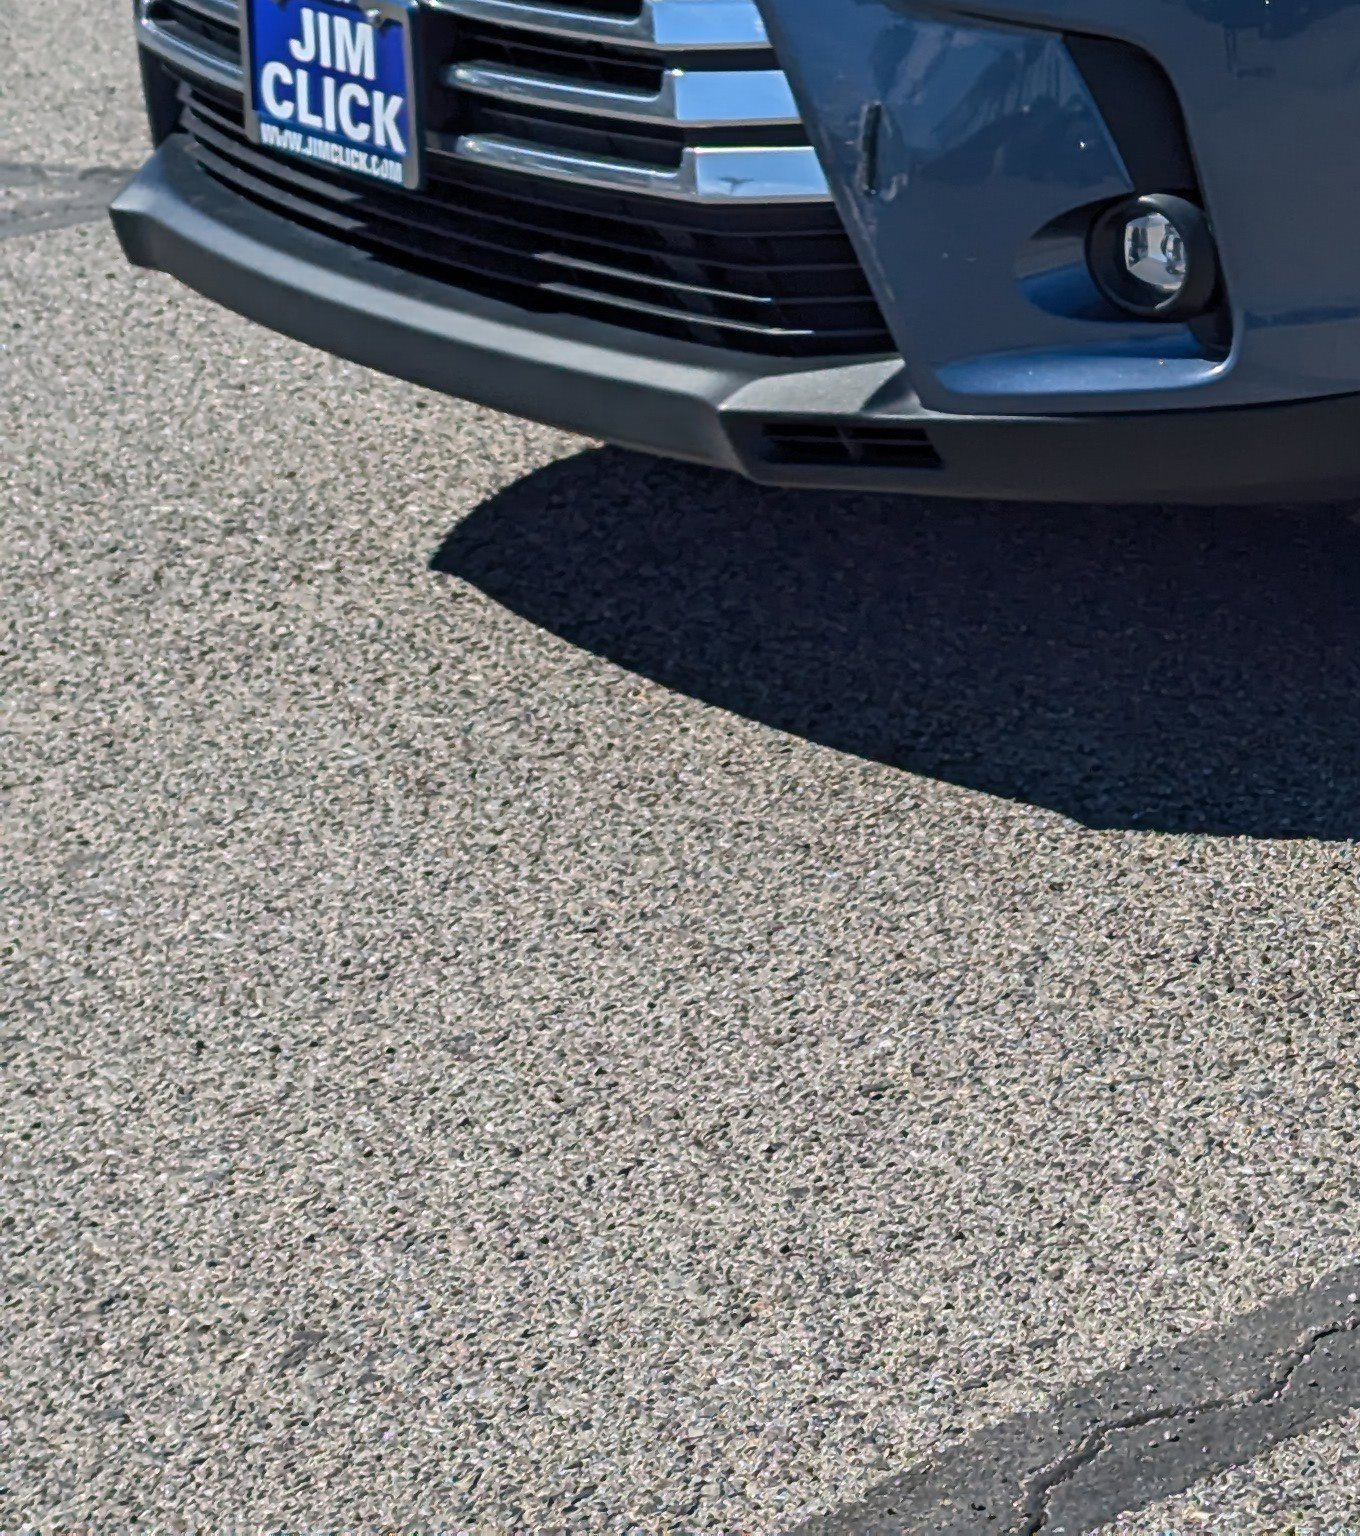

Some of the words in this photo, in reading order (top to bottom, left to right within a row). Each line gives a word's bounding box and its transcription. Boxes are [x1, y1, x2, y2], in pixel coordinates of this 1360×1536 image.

[289, 7, 376, 81] JIM
[261, 61, 406, 155] CLICK
[261, 123, 404, 183] WWW.JIMCLICK.COM
